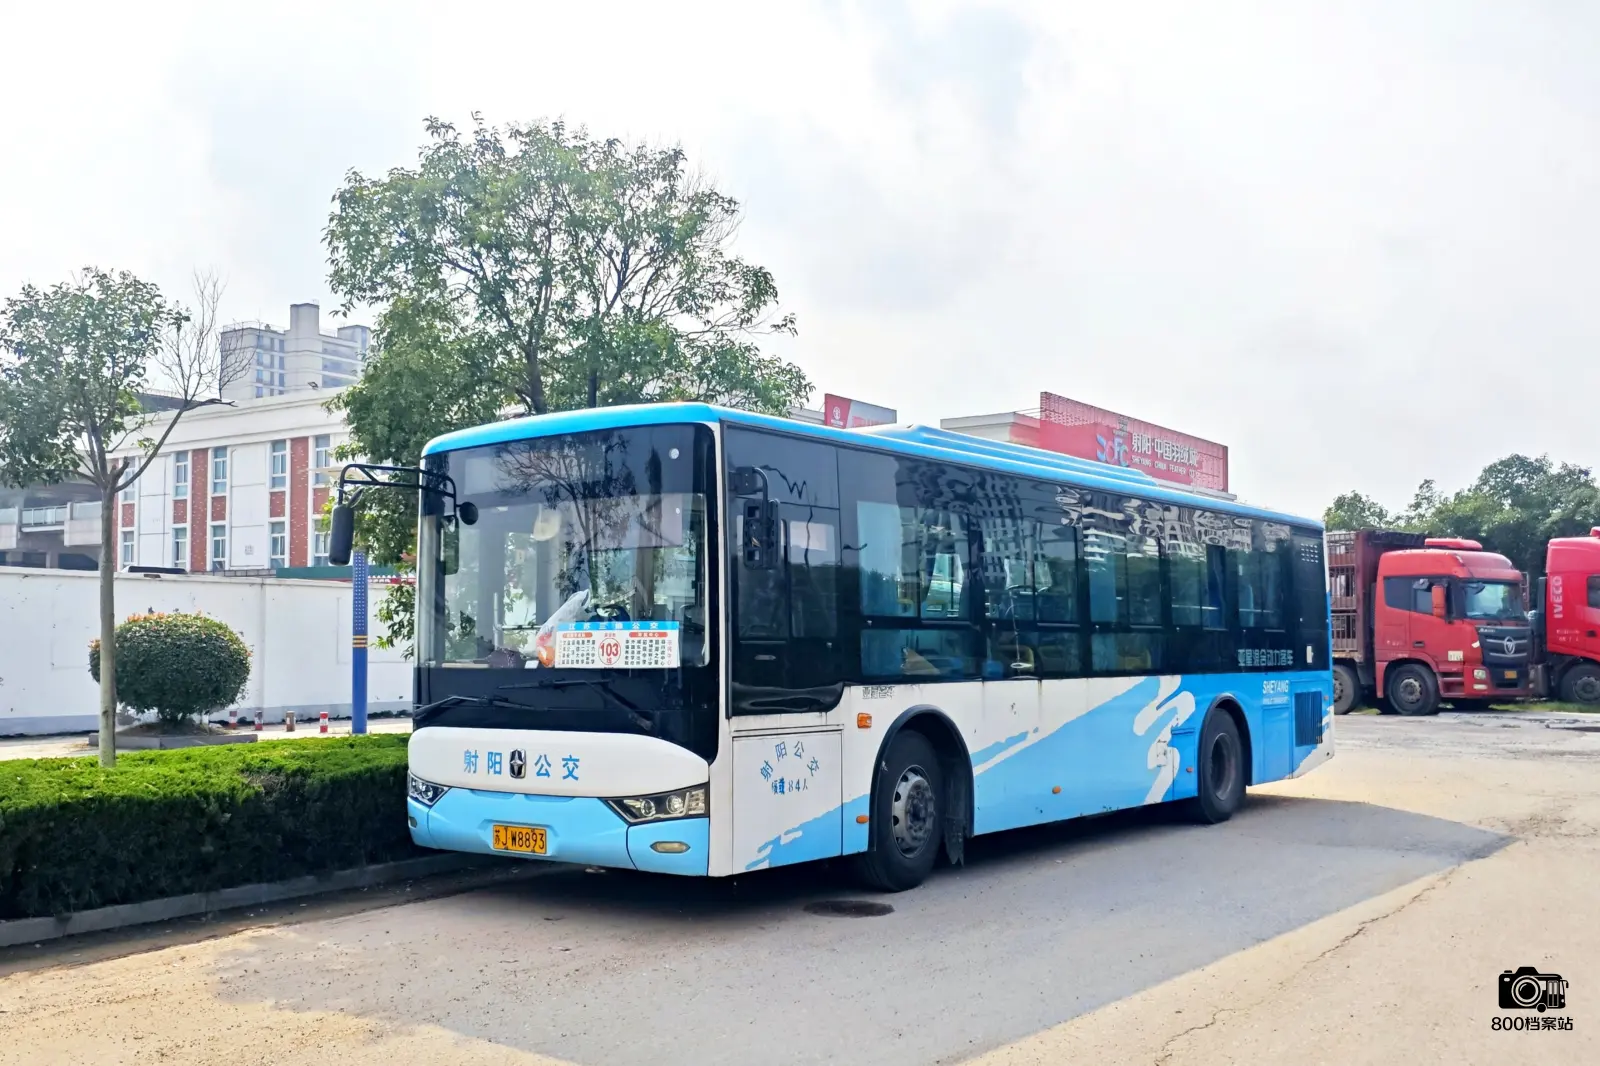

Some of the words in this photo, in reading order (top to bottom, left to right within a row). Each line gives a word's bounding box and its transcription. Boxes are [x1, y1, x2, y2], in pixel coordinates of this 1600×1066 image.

[1553, 576, 1563, 618] IVECO
[600, 643, 619, 657] 103
[1263, 680, 1289, 694] SHEYANG
